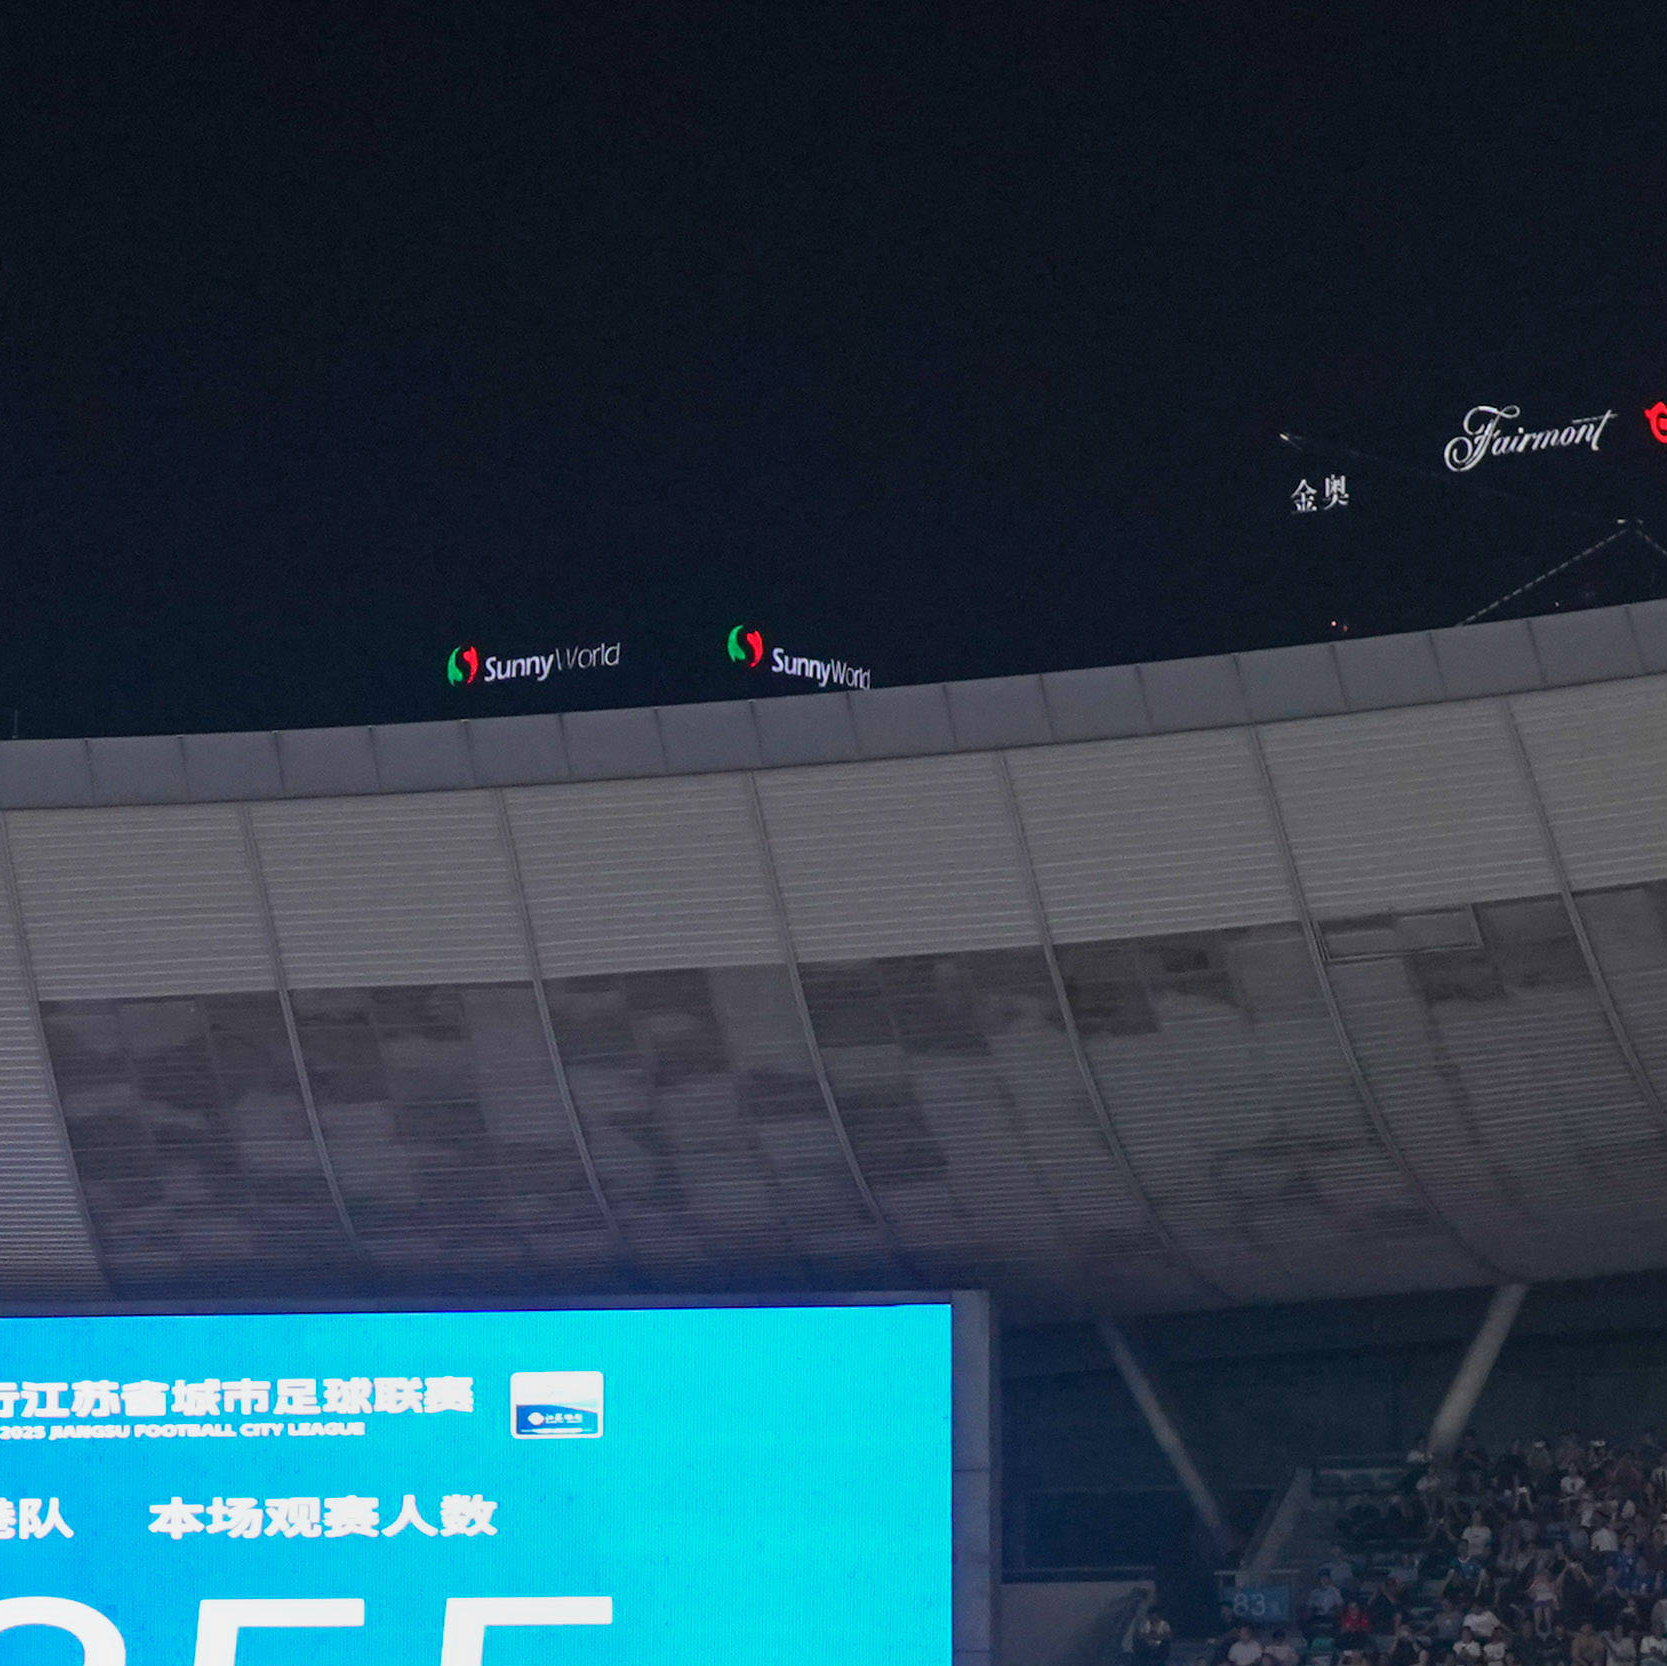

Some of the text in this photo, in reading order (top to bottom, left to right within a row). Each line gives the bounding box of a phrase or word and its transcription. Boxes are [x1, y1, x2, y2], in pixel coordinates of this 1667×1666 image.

[1444, 405, 1617, 472] Fairmont
[1291, 474, 1350, 513] 金奥
[148, 1495, 498, 1540] 本场观赛人数
